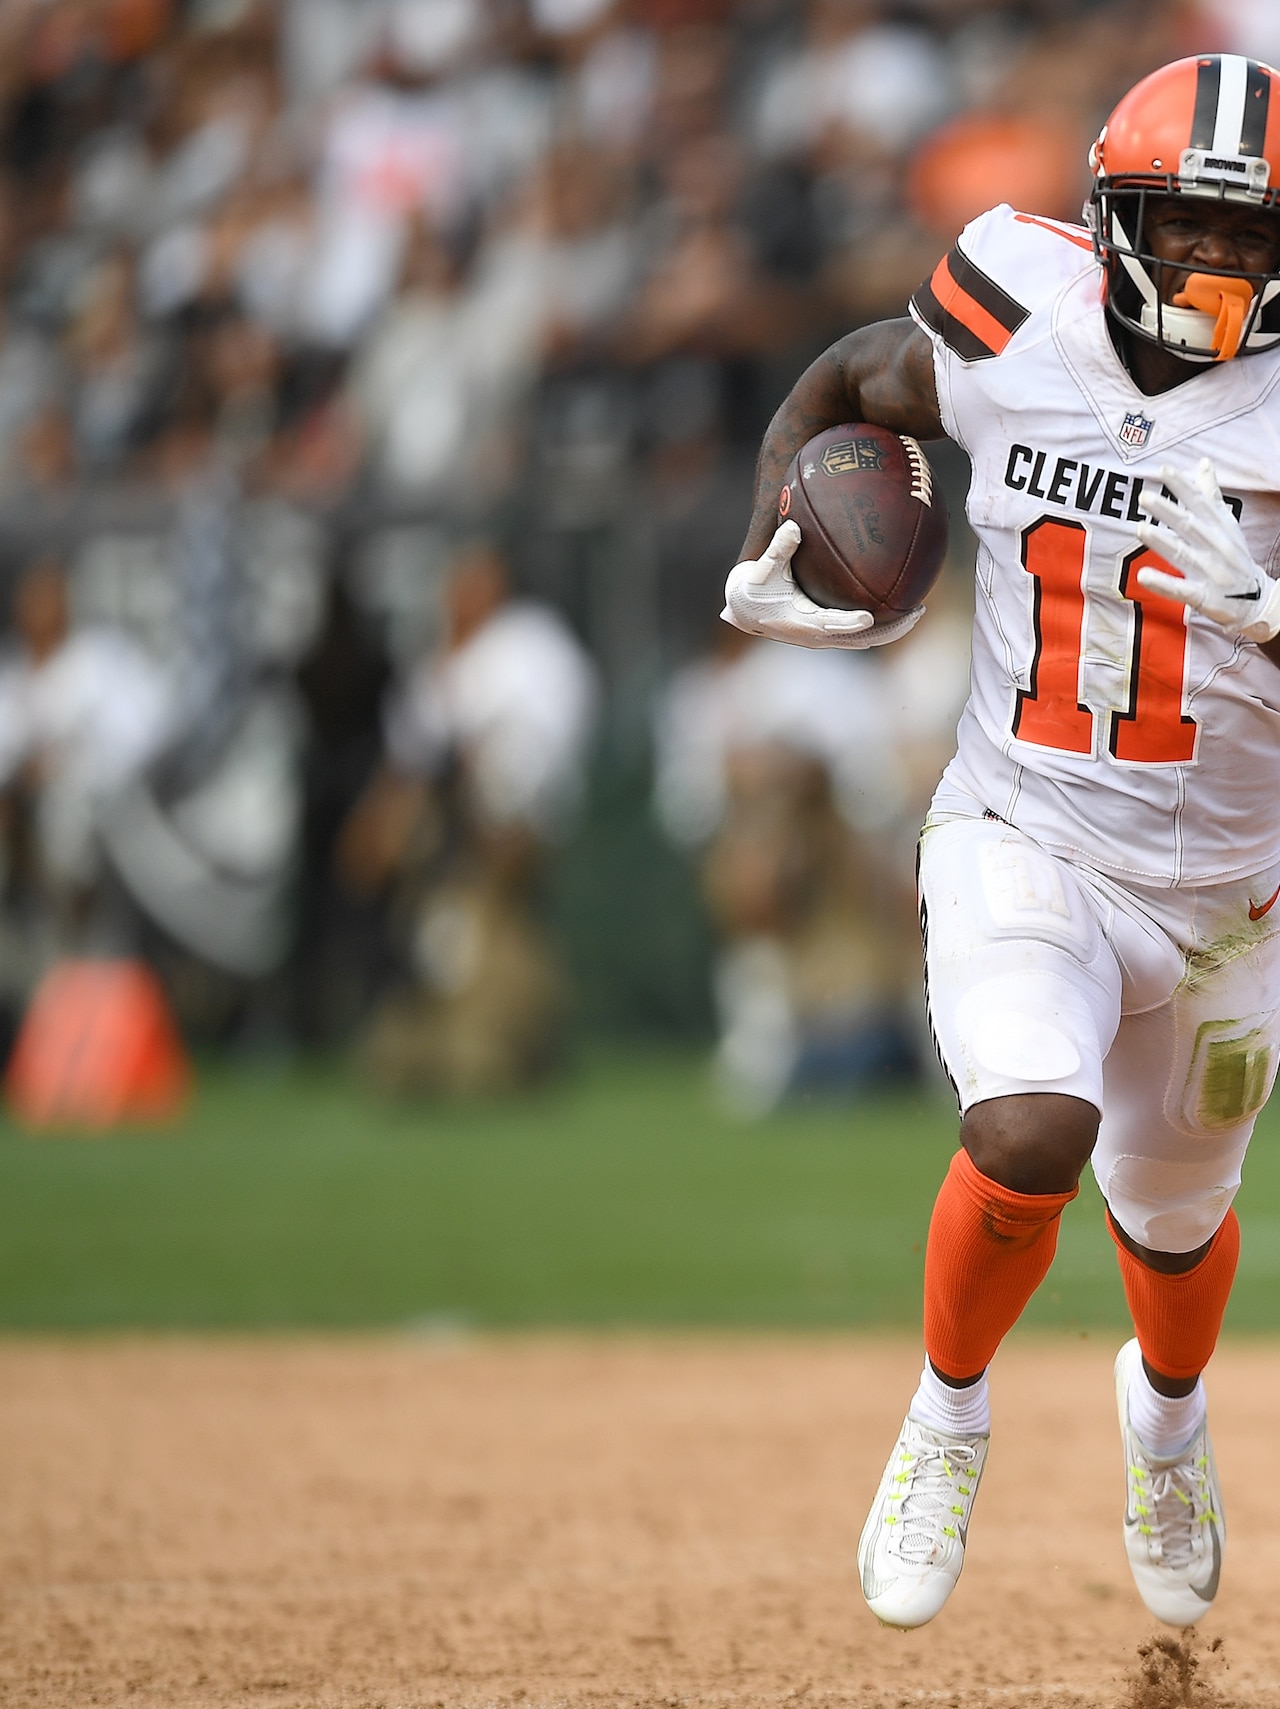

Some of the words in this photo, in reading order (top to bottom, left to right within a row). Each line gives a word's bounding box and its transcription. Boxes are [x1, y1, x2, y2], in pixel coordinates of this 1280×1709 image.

[1204, 158, 1246, 173] BROWNS
[1122, 425, 1144, 443] NFL
[1009, 513, 1199, 766] 11
